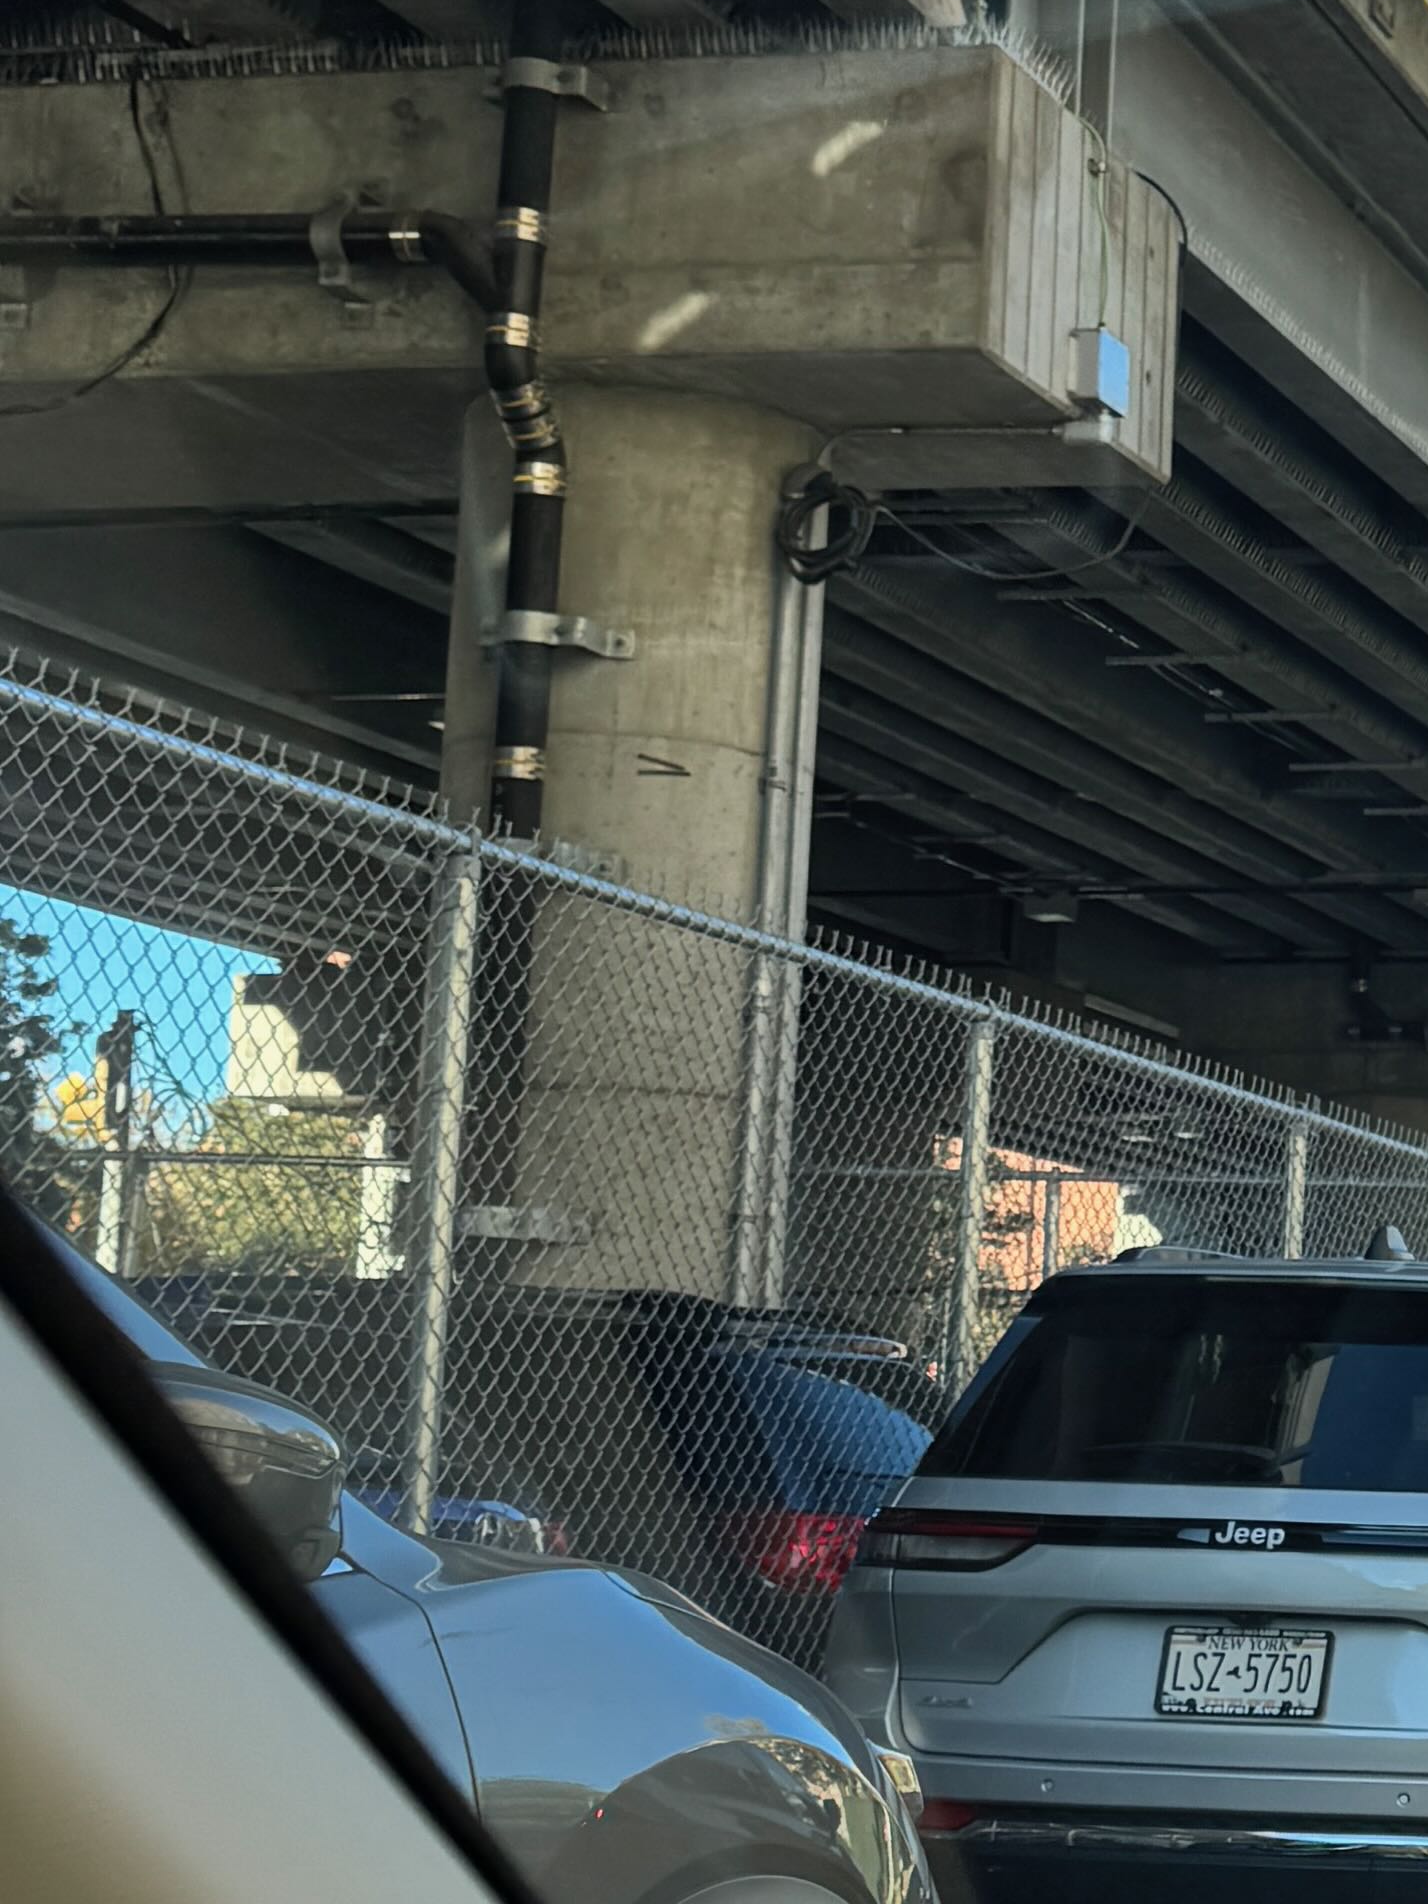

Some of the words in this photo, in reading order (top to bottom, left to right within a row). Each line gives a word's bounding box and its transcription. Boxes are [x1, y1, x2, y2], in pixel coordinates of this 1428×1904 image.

[1214, 1521, 1286, 1550] Jeep
[1208, 1635, 1247, 1650] NEW
[1249, 1636, 1290, 1652] YORK
